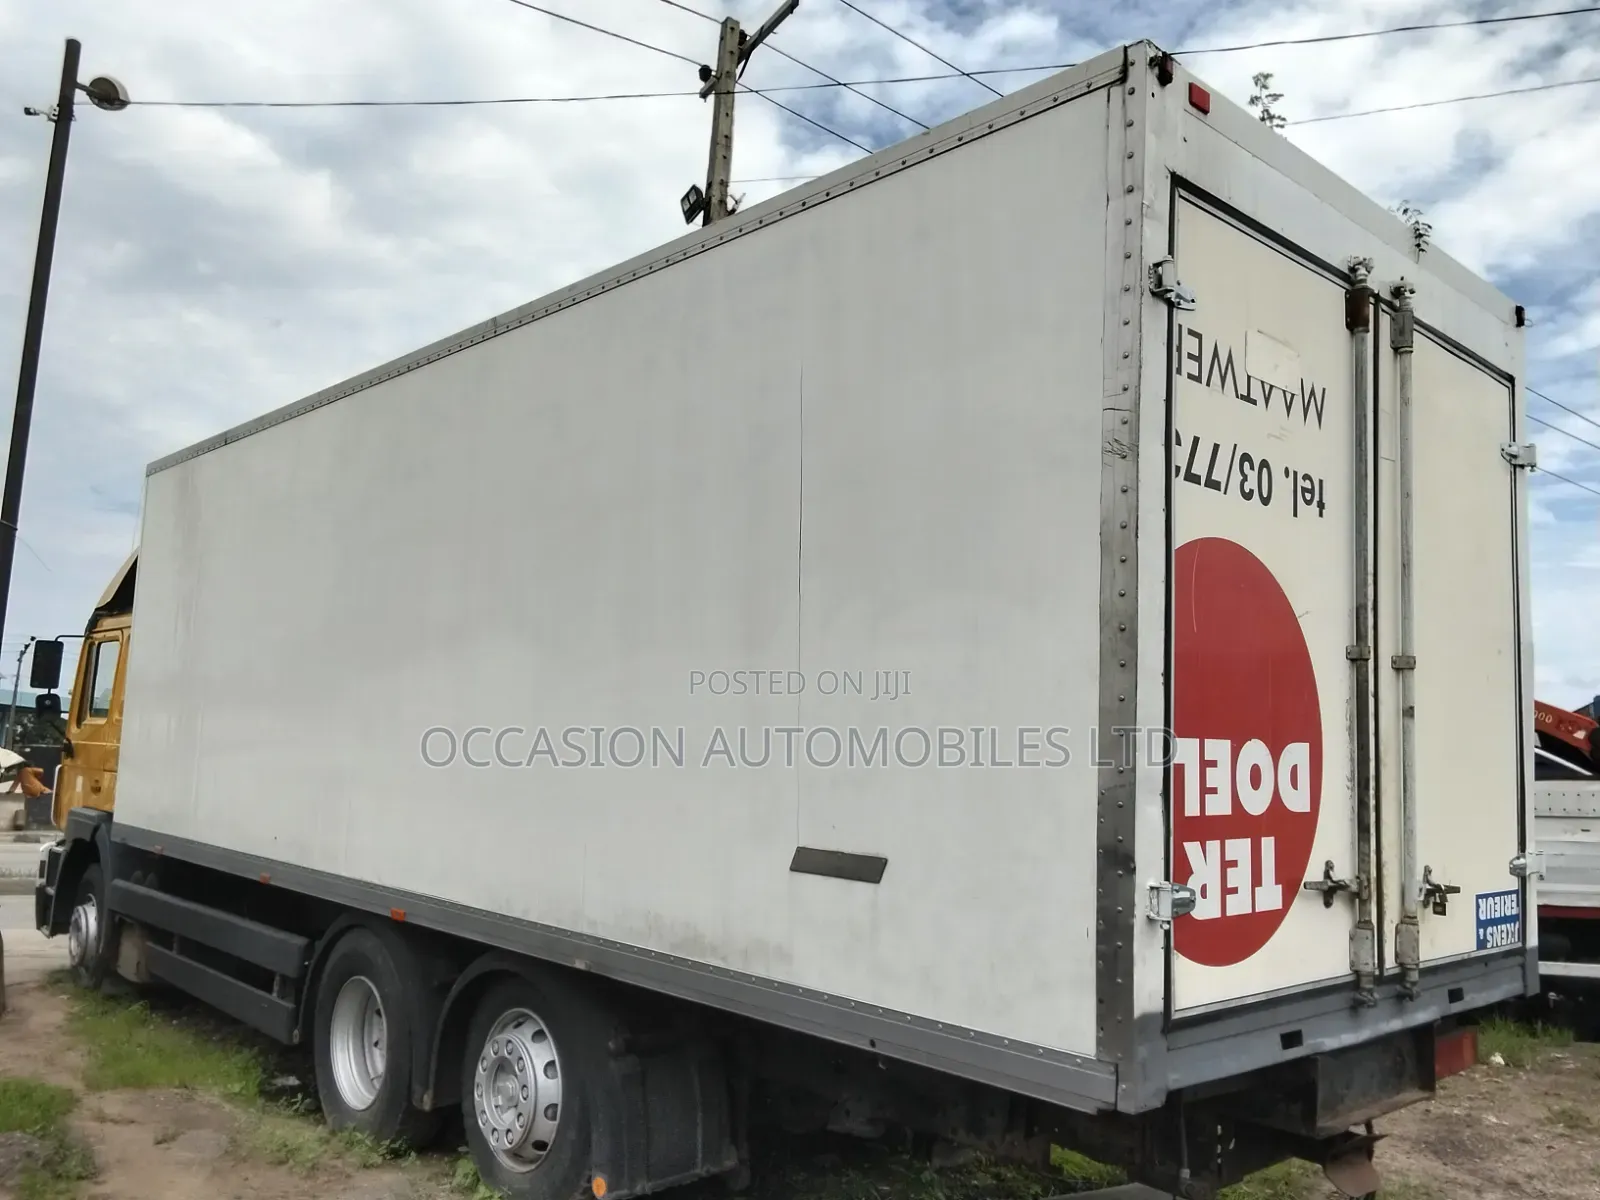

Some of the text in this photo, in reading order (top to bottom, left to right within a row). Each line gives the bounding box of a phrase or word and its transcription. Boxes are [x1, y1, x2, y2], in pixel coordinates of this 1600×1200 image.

[1284, 466, 1326, 518] tel.
[1174, 737, 1311, 817] DOEL
[1183, 836, 1283, 921] TER
[1478, 893, 1519, 921] ERIEUR
